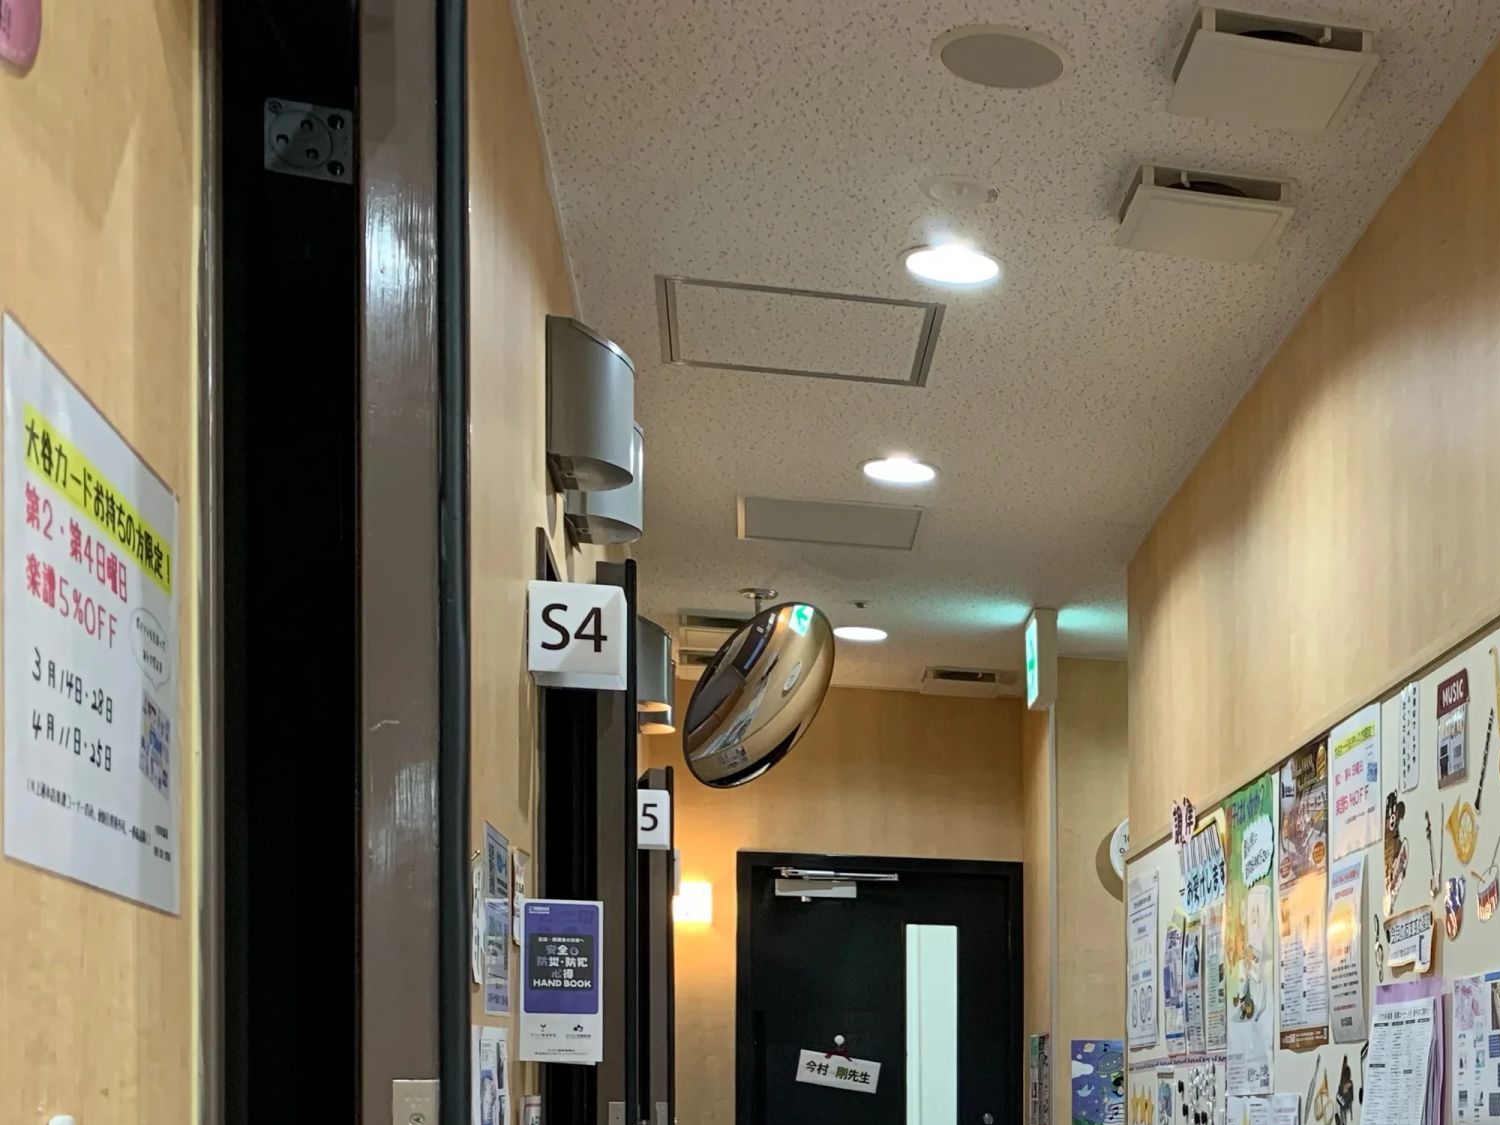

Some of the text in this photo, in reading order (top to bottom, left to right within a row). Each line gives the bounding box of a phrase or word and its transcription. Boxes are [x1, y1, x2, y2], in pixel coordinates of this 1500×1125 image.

[25, 481, 127, 604] 第2・第4日曜日
[26, 553, 117, 648] 楽譜5%OFF
[540, 602, 608, 653] S4
[1442, 678, 1464, 707] MUSIC
[537, 957, 588, 969] 防災・防犯
[533, 979, 592, 988] HAND BOOK
[806, 1060, 871, 1085] 今村 剛先生
